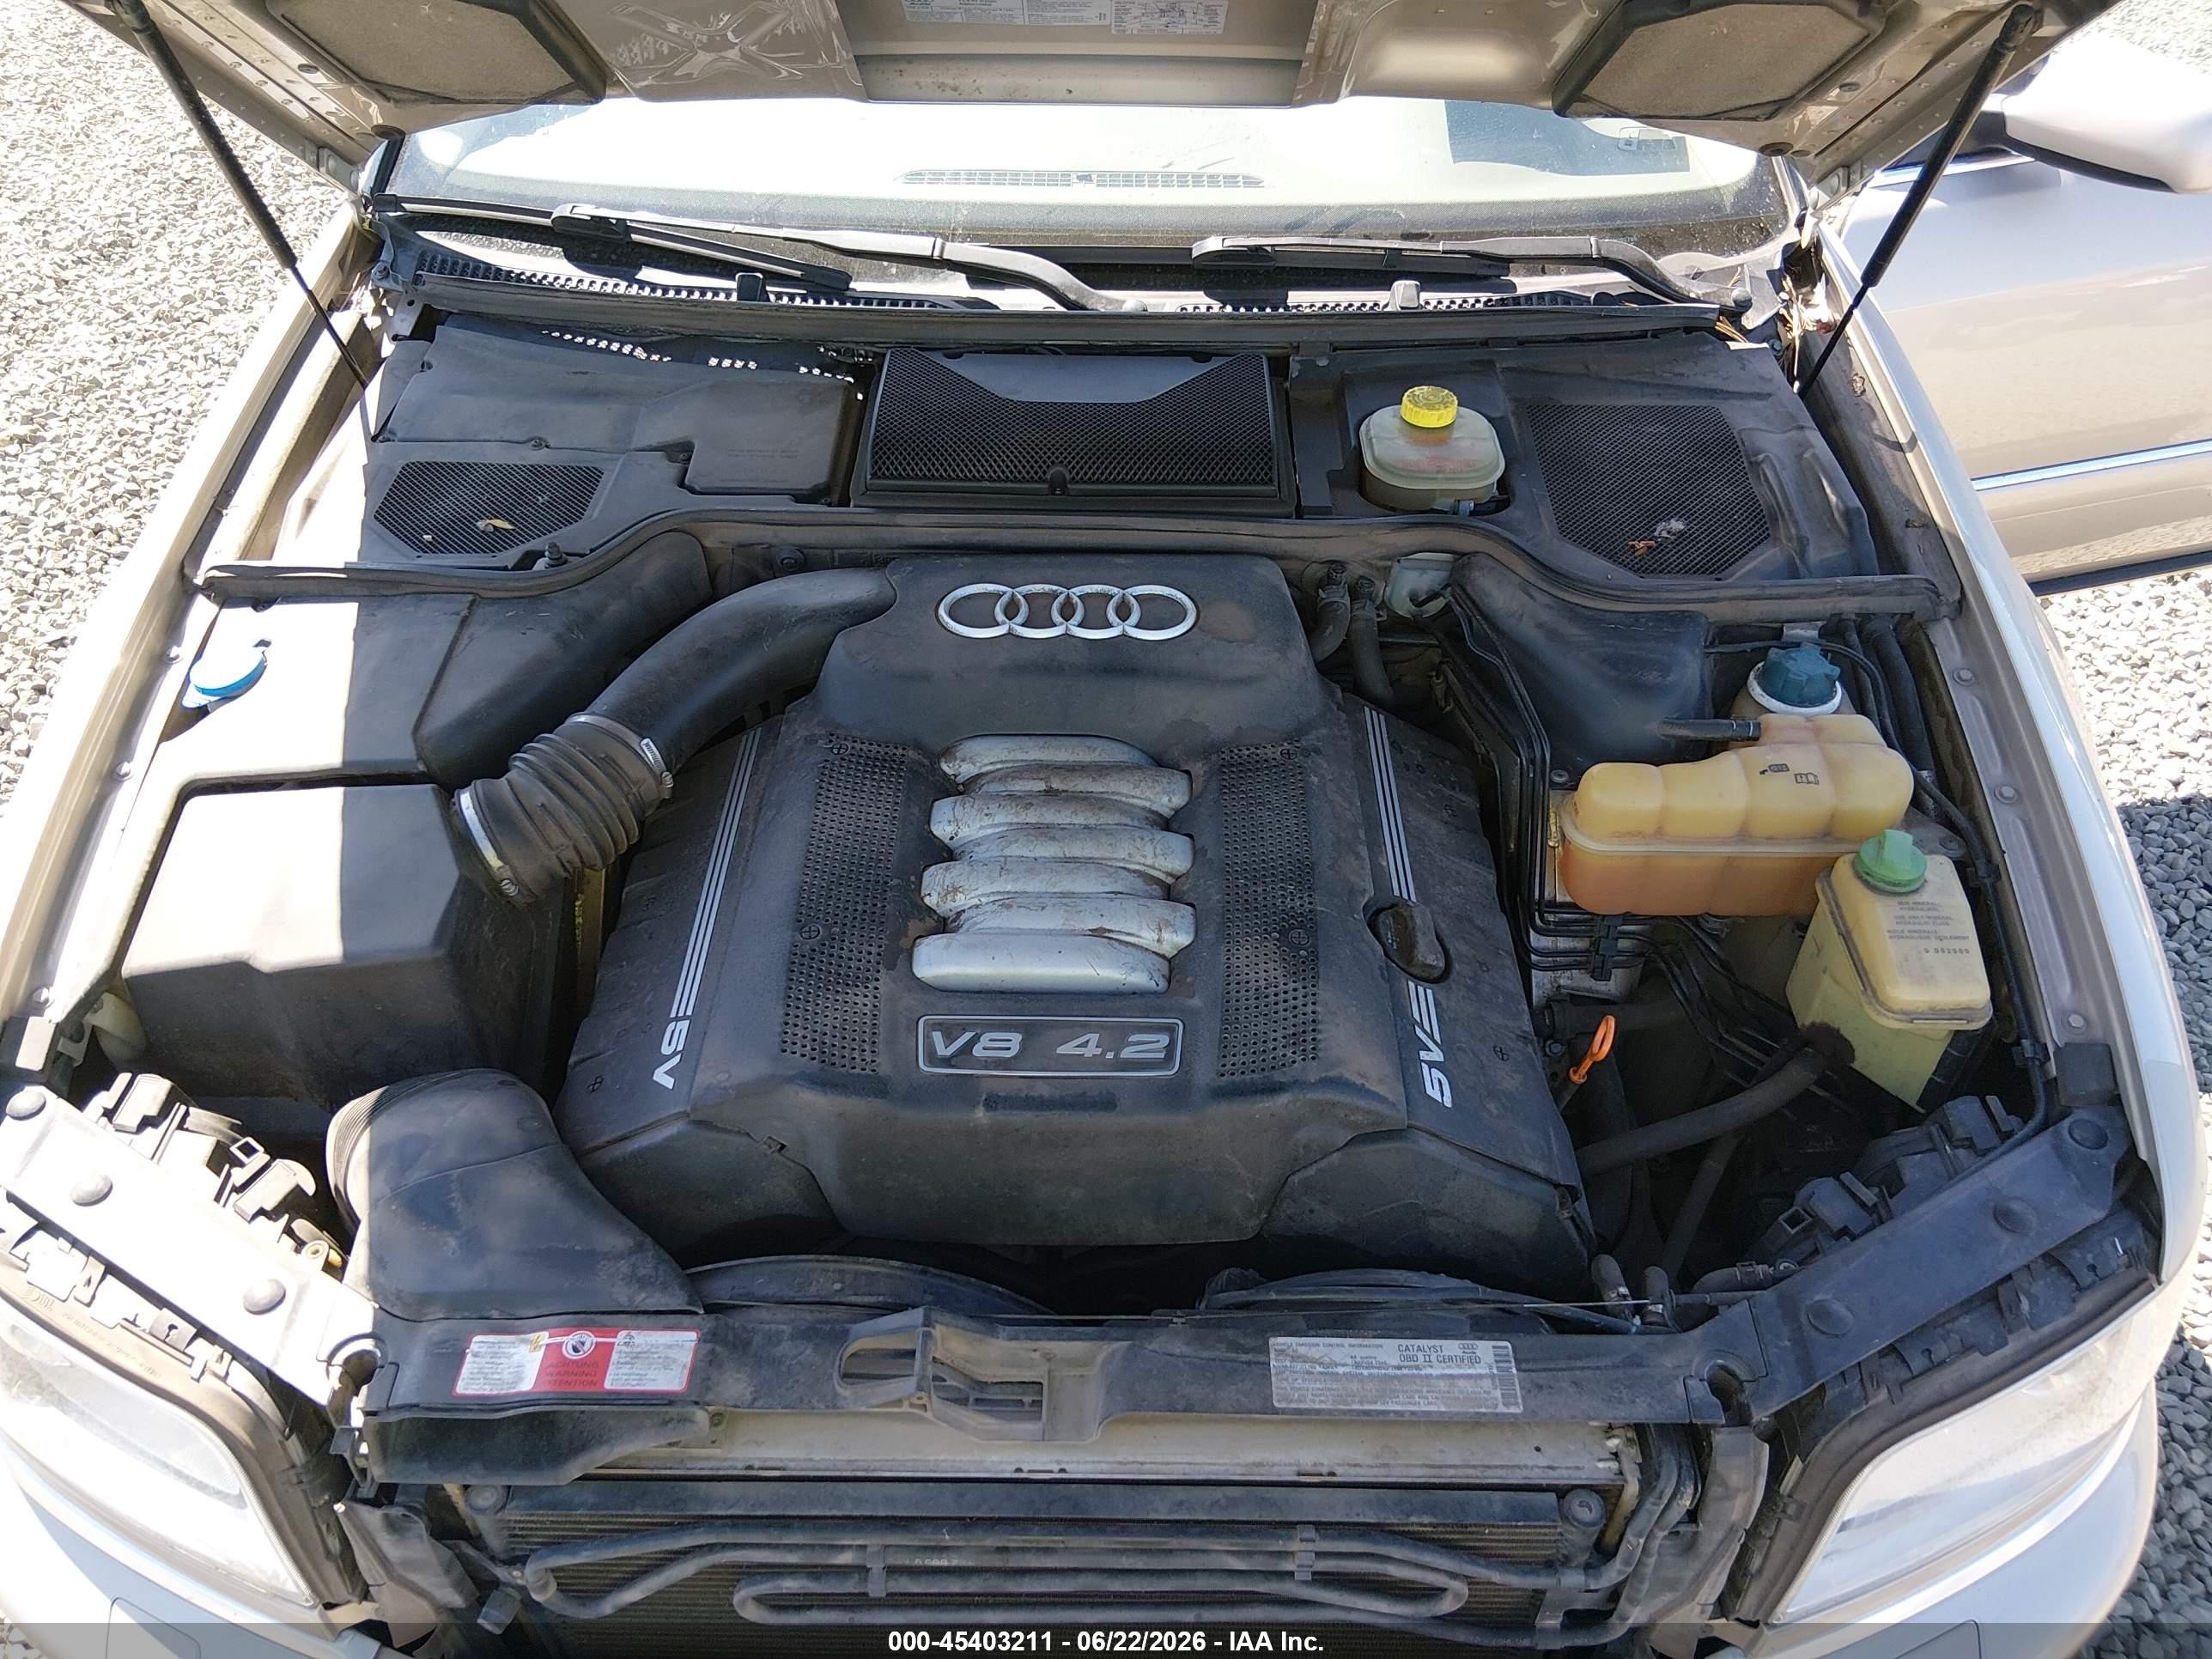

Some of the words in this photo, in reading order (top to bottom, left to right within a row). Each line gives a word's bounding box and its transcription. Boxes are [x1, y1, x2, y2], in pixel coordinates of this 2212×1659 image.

[931, 1030, 1023, 1057] V8
[1055, 1032, 1170, 1059] 4.2
[652, 1018, 693, 1091] 5V
[1398, 1344, 1443, 1353] CATALYST
[1400, 1354, 1418, 1363] OBD
[1422, 1354, 1432, 1363] II
[1437, 1354, 1481, 1364] CERTIFIED
